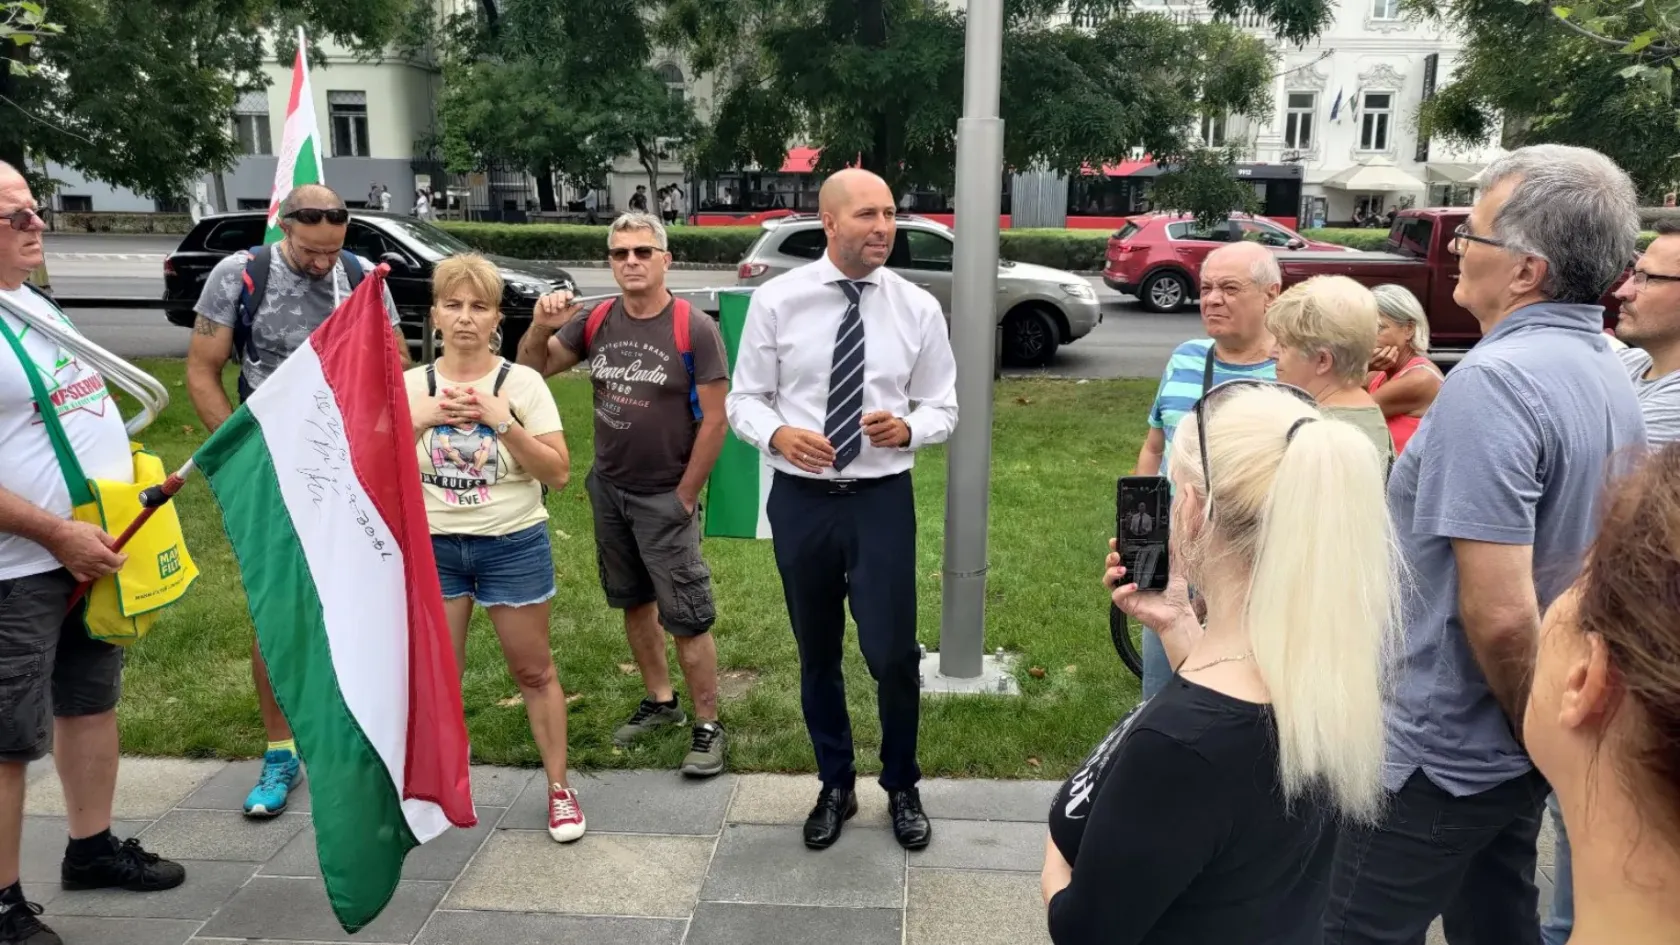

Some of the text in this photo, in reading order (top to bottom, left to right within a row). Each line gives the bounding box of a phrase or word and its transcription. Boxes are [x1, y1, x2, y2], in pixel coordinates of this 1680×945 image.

[642, 343, 670, 361] BRAND
[591, 353, 668, 385] Pierre Cardin
[611, 394, 651, 408] HERITAGE
[423, 474, 481, 489] MY RULES
[445, 487, 491, 505] NEVER
